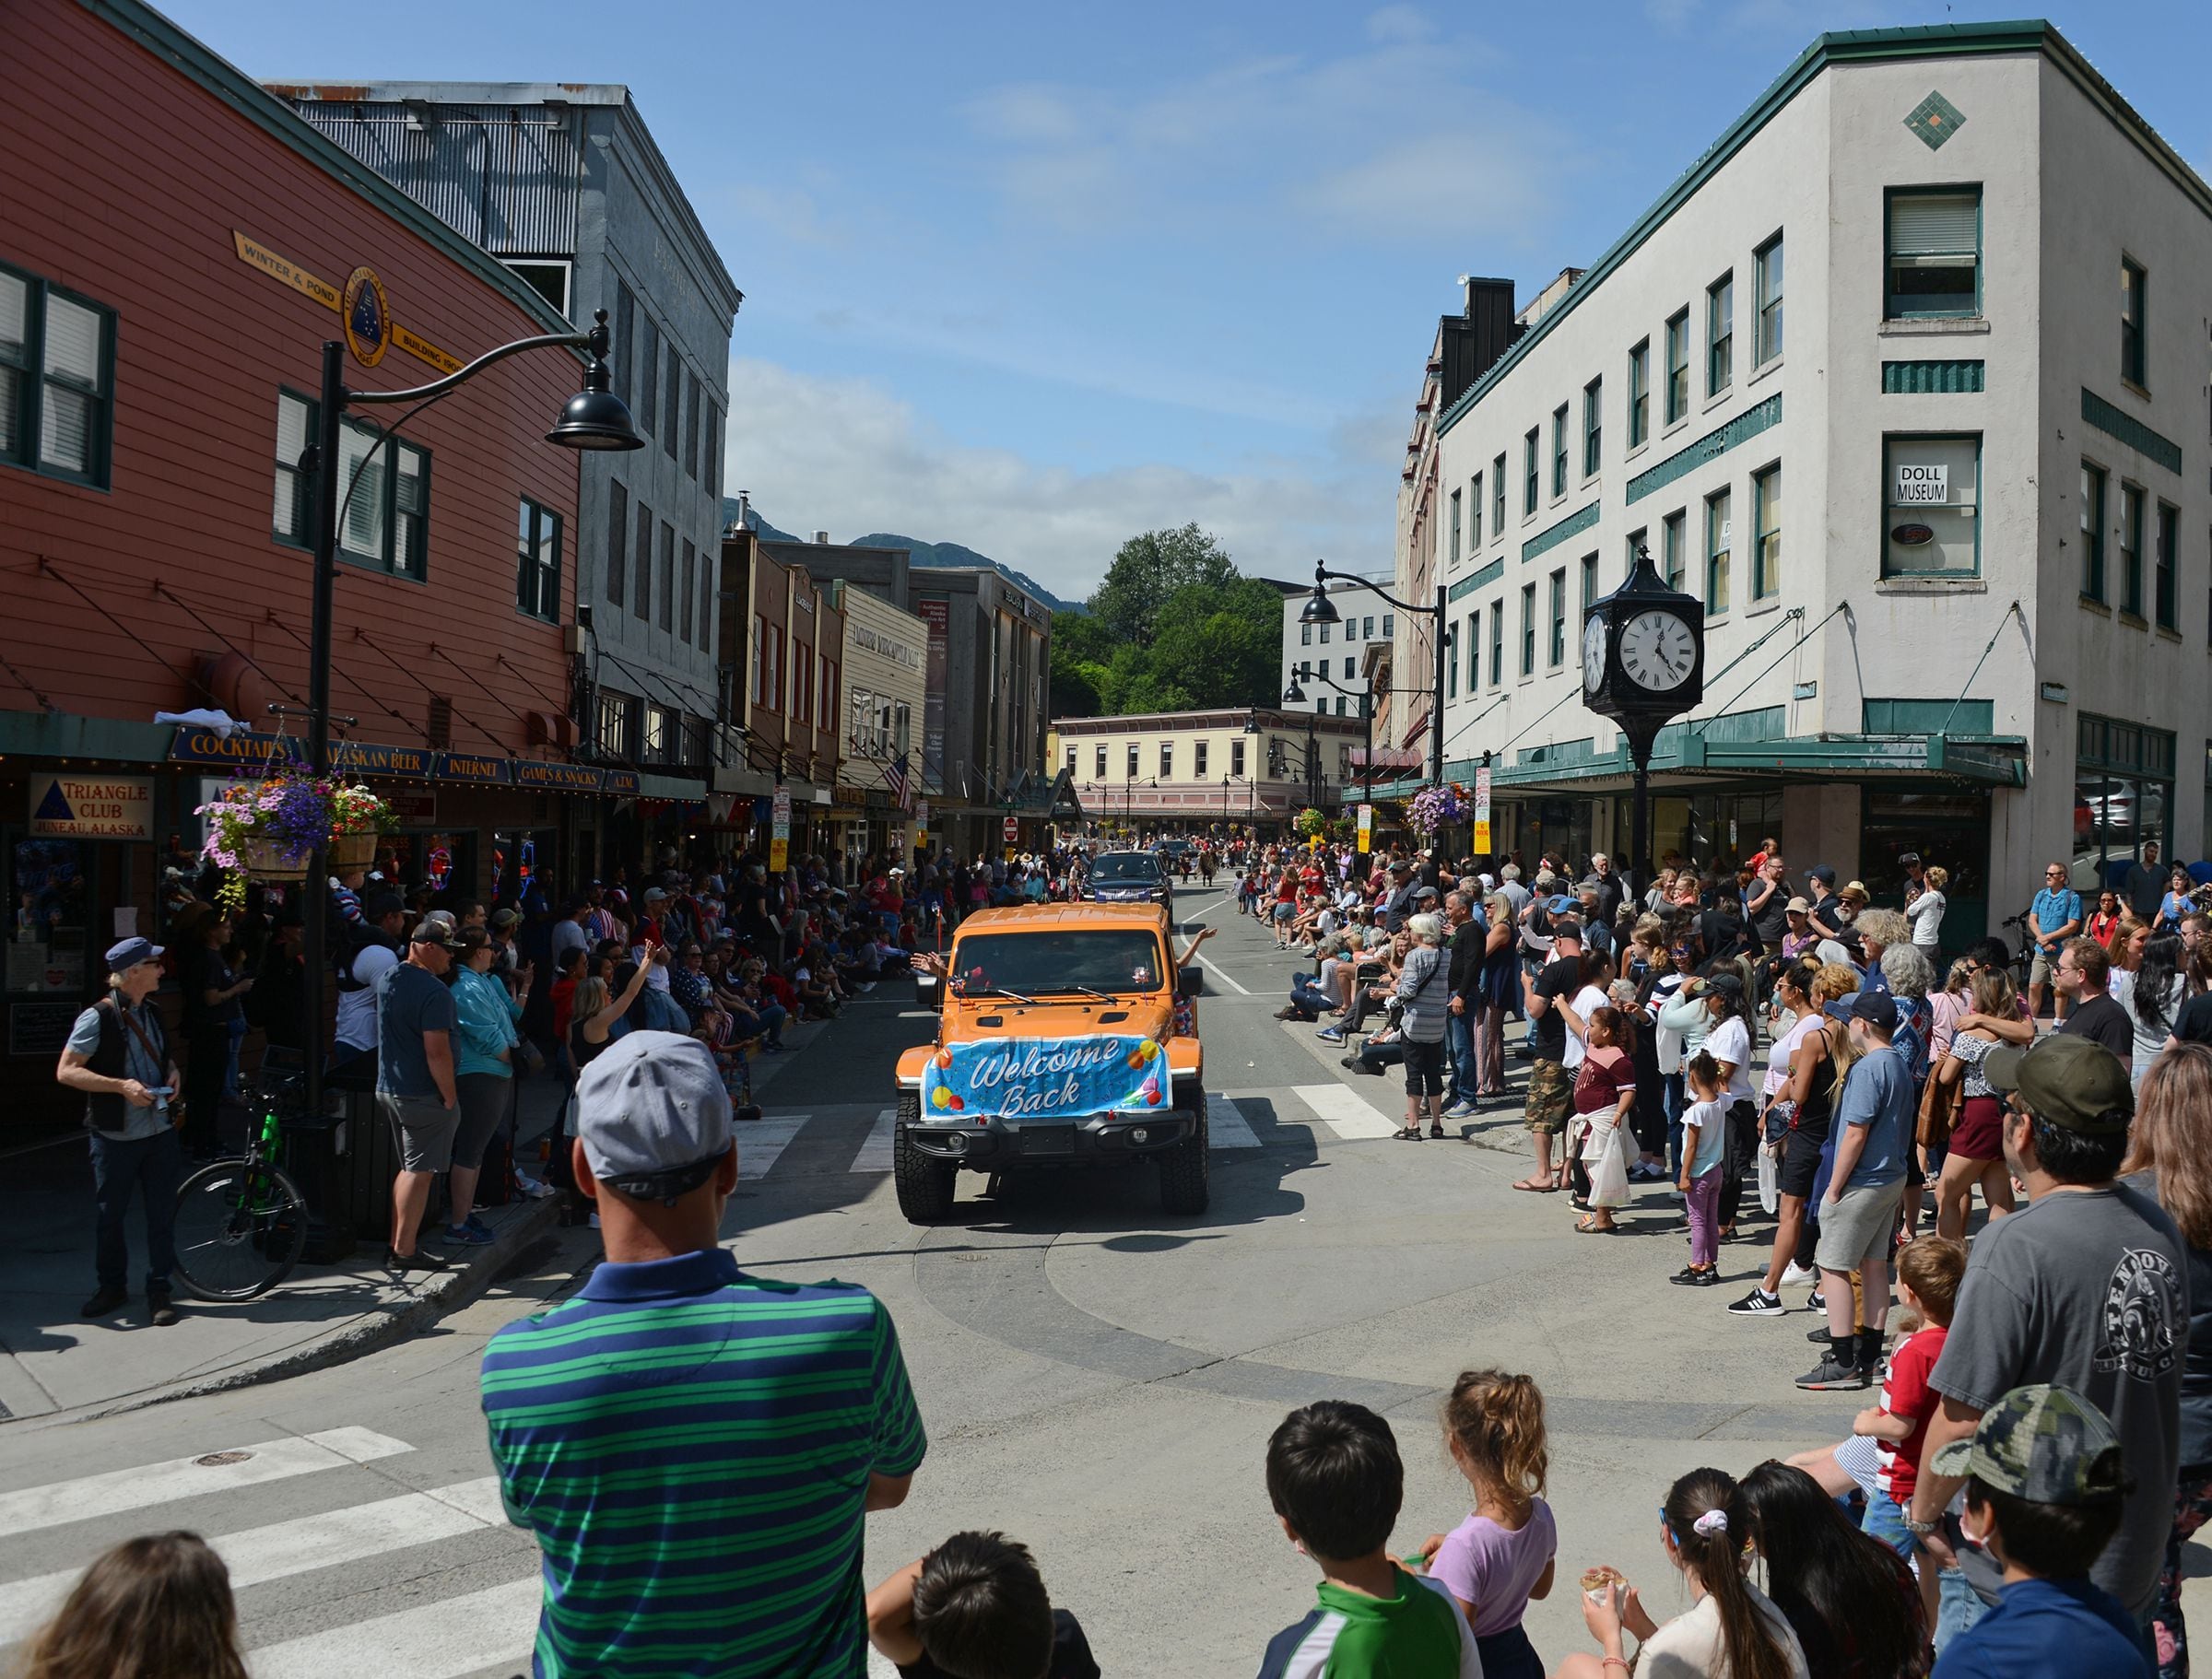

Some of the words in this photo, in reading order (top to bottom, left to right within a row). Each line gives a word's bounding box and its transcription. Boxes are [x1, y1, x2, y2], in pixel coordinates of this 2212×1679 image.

[244, 243, 290, 276] WINTER
[294, 276, 303, 286] &
[307, 280, 335, 303] POND
[403, 335, 441, 364] BUILDING
[1901, 467, 1941, 480] DOLL
[1897, 484, 1945, 500] MUSEUM
[191, 735, 287, 758] COCKTAILS
[391, 749, 420, 770] BEER
[450, 759, 499, 777] INTERNET
[521, 767, 553, 781] GAMES
[555, 769, 563, 781] &
[565, 771, 597, 785] SNACKS
[65, 783, 147, 800] TRIANGLE
[80, 804, 122, 818] CLUB
[92, 824, 145, 836] ALASKA
[970, 1039, 1119, 1089] Welcome
[999, 1073, 1080, 1117] Back
